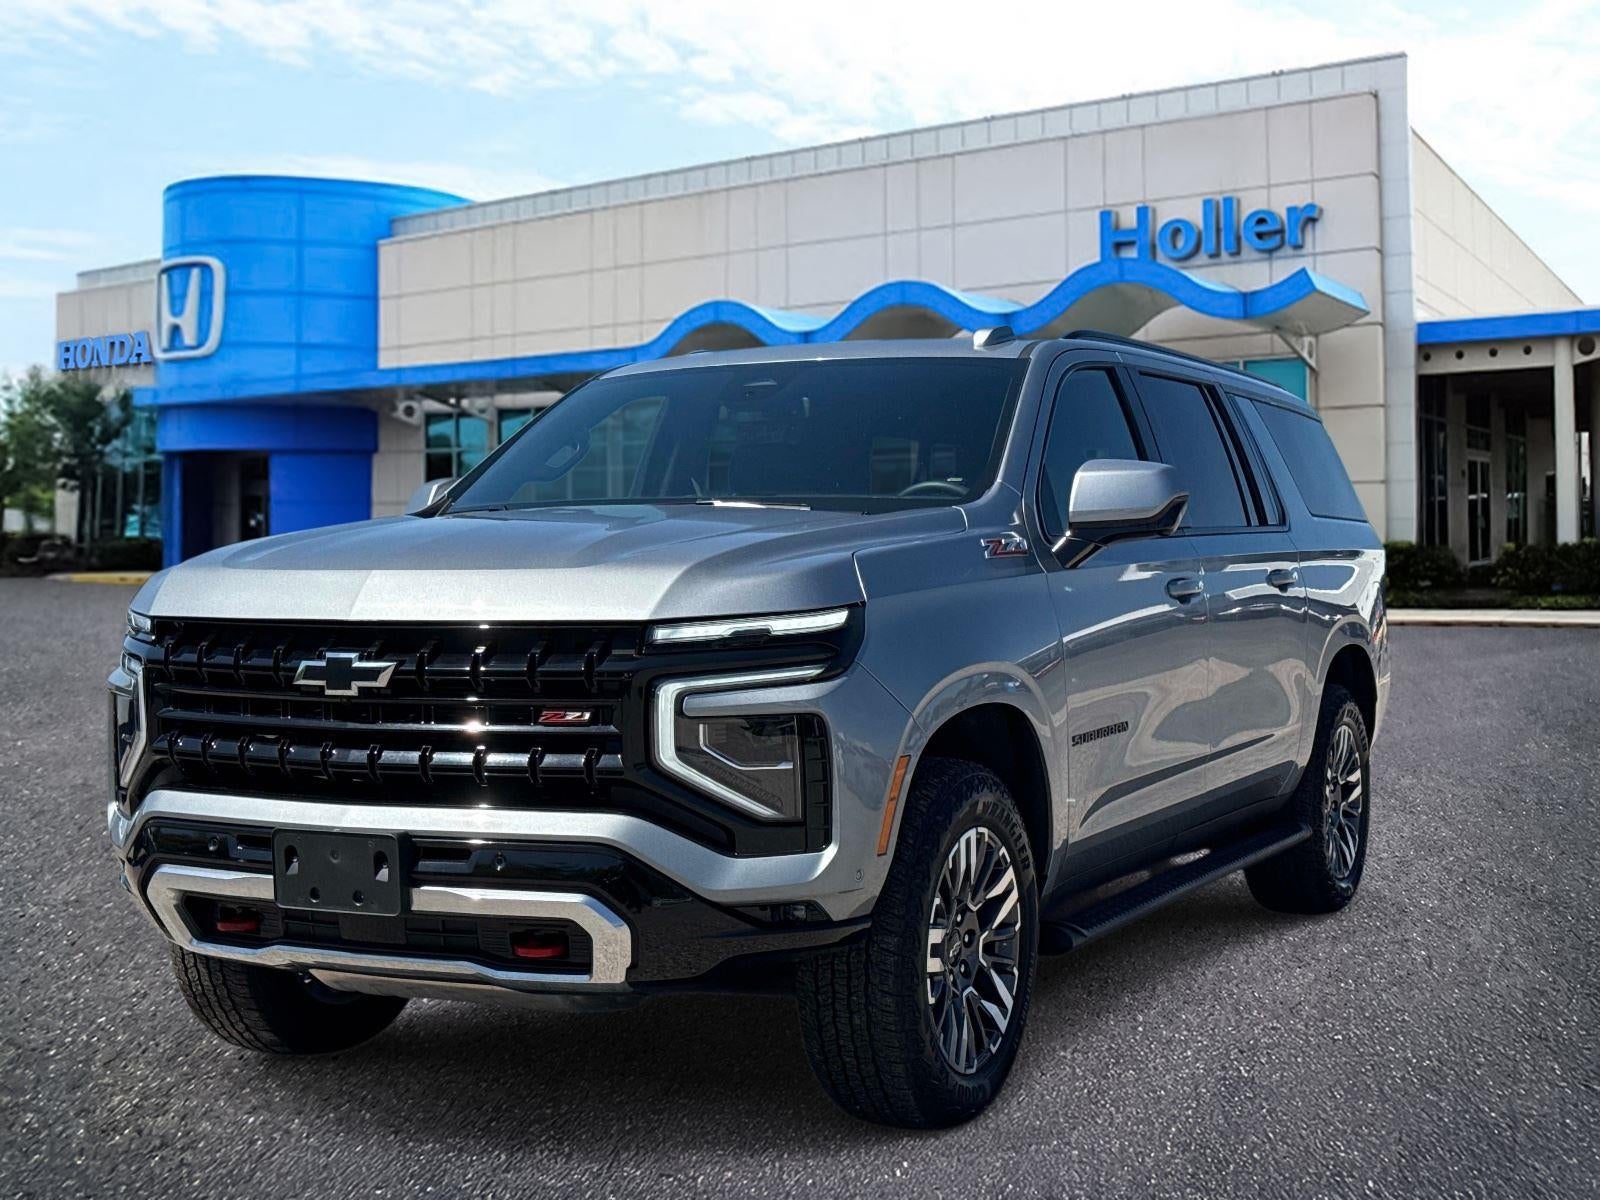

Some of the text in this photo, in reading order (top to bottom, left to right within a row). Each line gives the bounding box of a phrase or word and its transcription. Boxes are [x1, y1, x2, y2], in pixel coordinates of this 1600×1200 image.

[1099, 196, 1321, 260] Holler
[58, 331, 152, 370] HONDA
[539, 711, 591, 722] Z71
[1071, 721, 1129, 747] SUBURBAN
